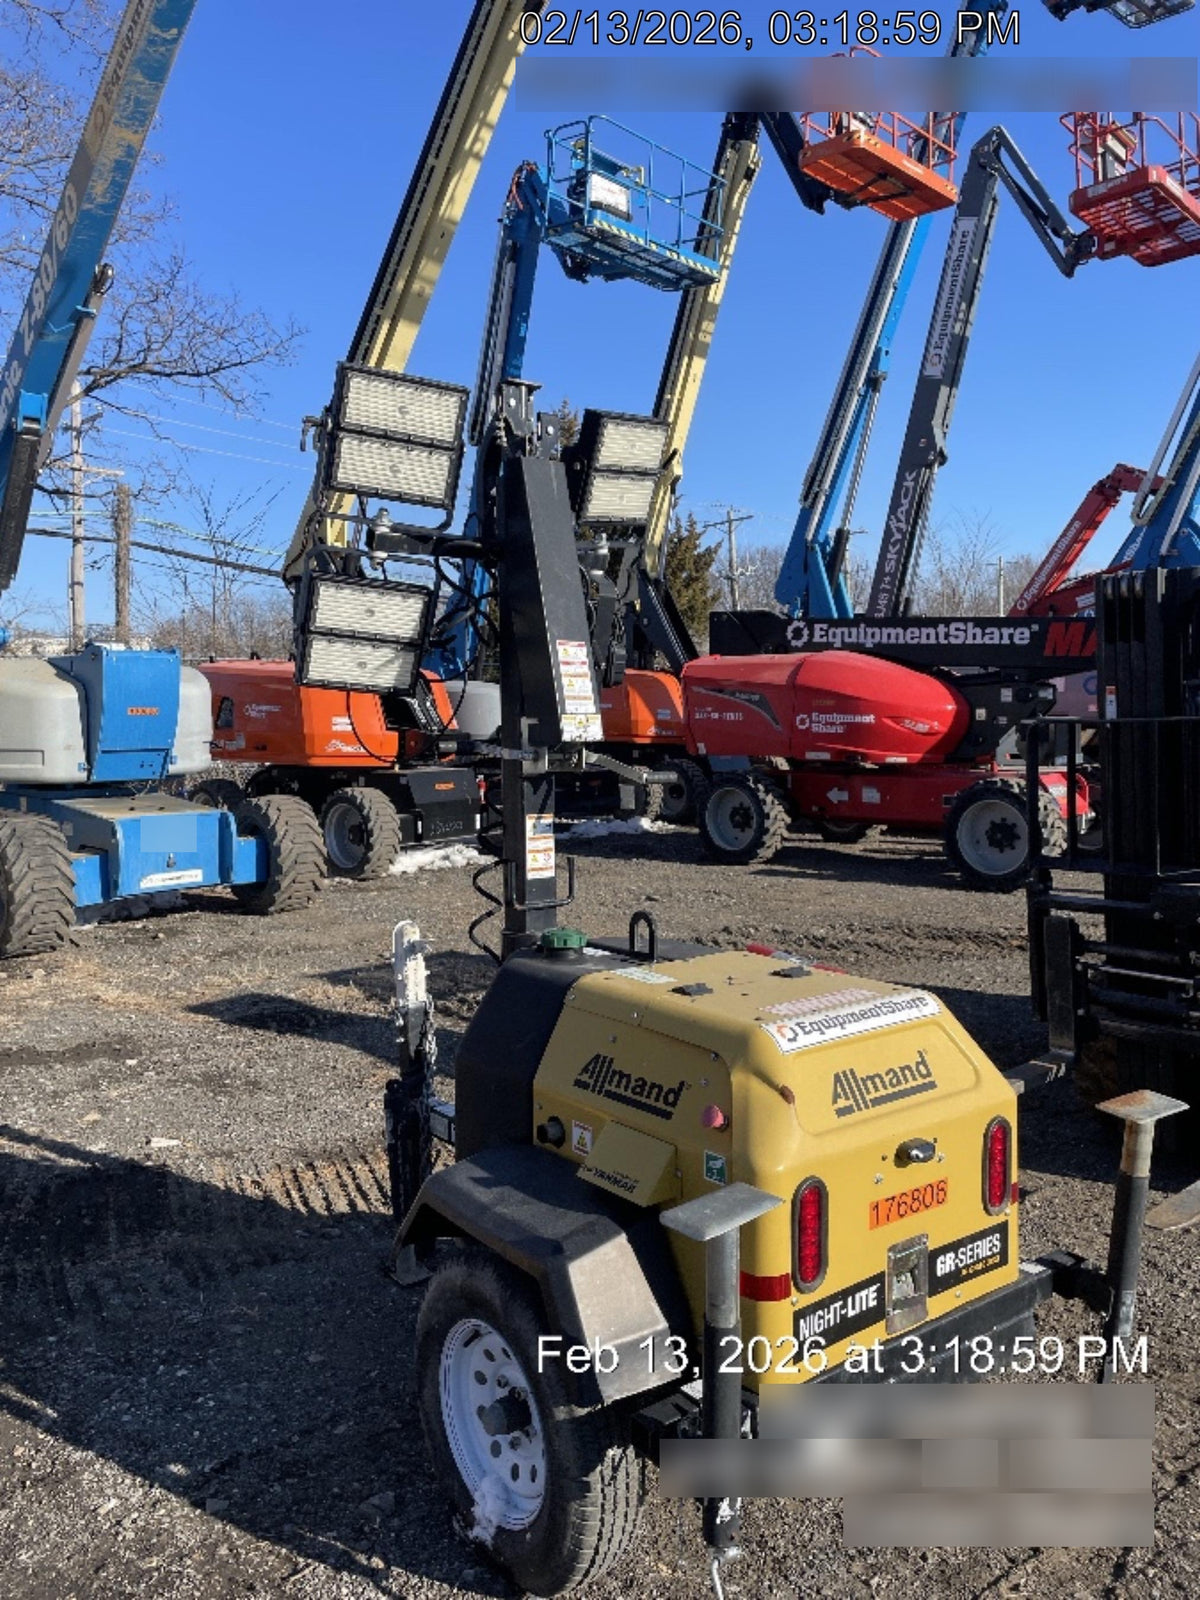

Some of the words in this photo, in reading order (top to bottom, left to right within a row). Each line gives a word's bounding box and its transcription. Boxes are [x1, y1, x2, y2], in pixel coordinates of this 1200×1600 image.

[19, 182, 78, 356] Z-80/60
[884, 469, 919, 573] SKYJACK
[812, 622, 1031, 648] EquipmentShare
[795, 996, 930, 1036] EquipmentShare
[577, 1052, 686, 1108] Allmand
[832, 1049, 933, 1112] Allmand
[799, 1286, 879, 1341] NIGHT-LITE
